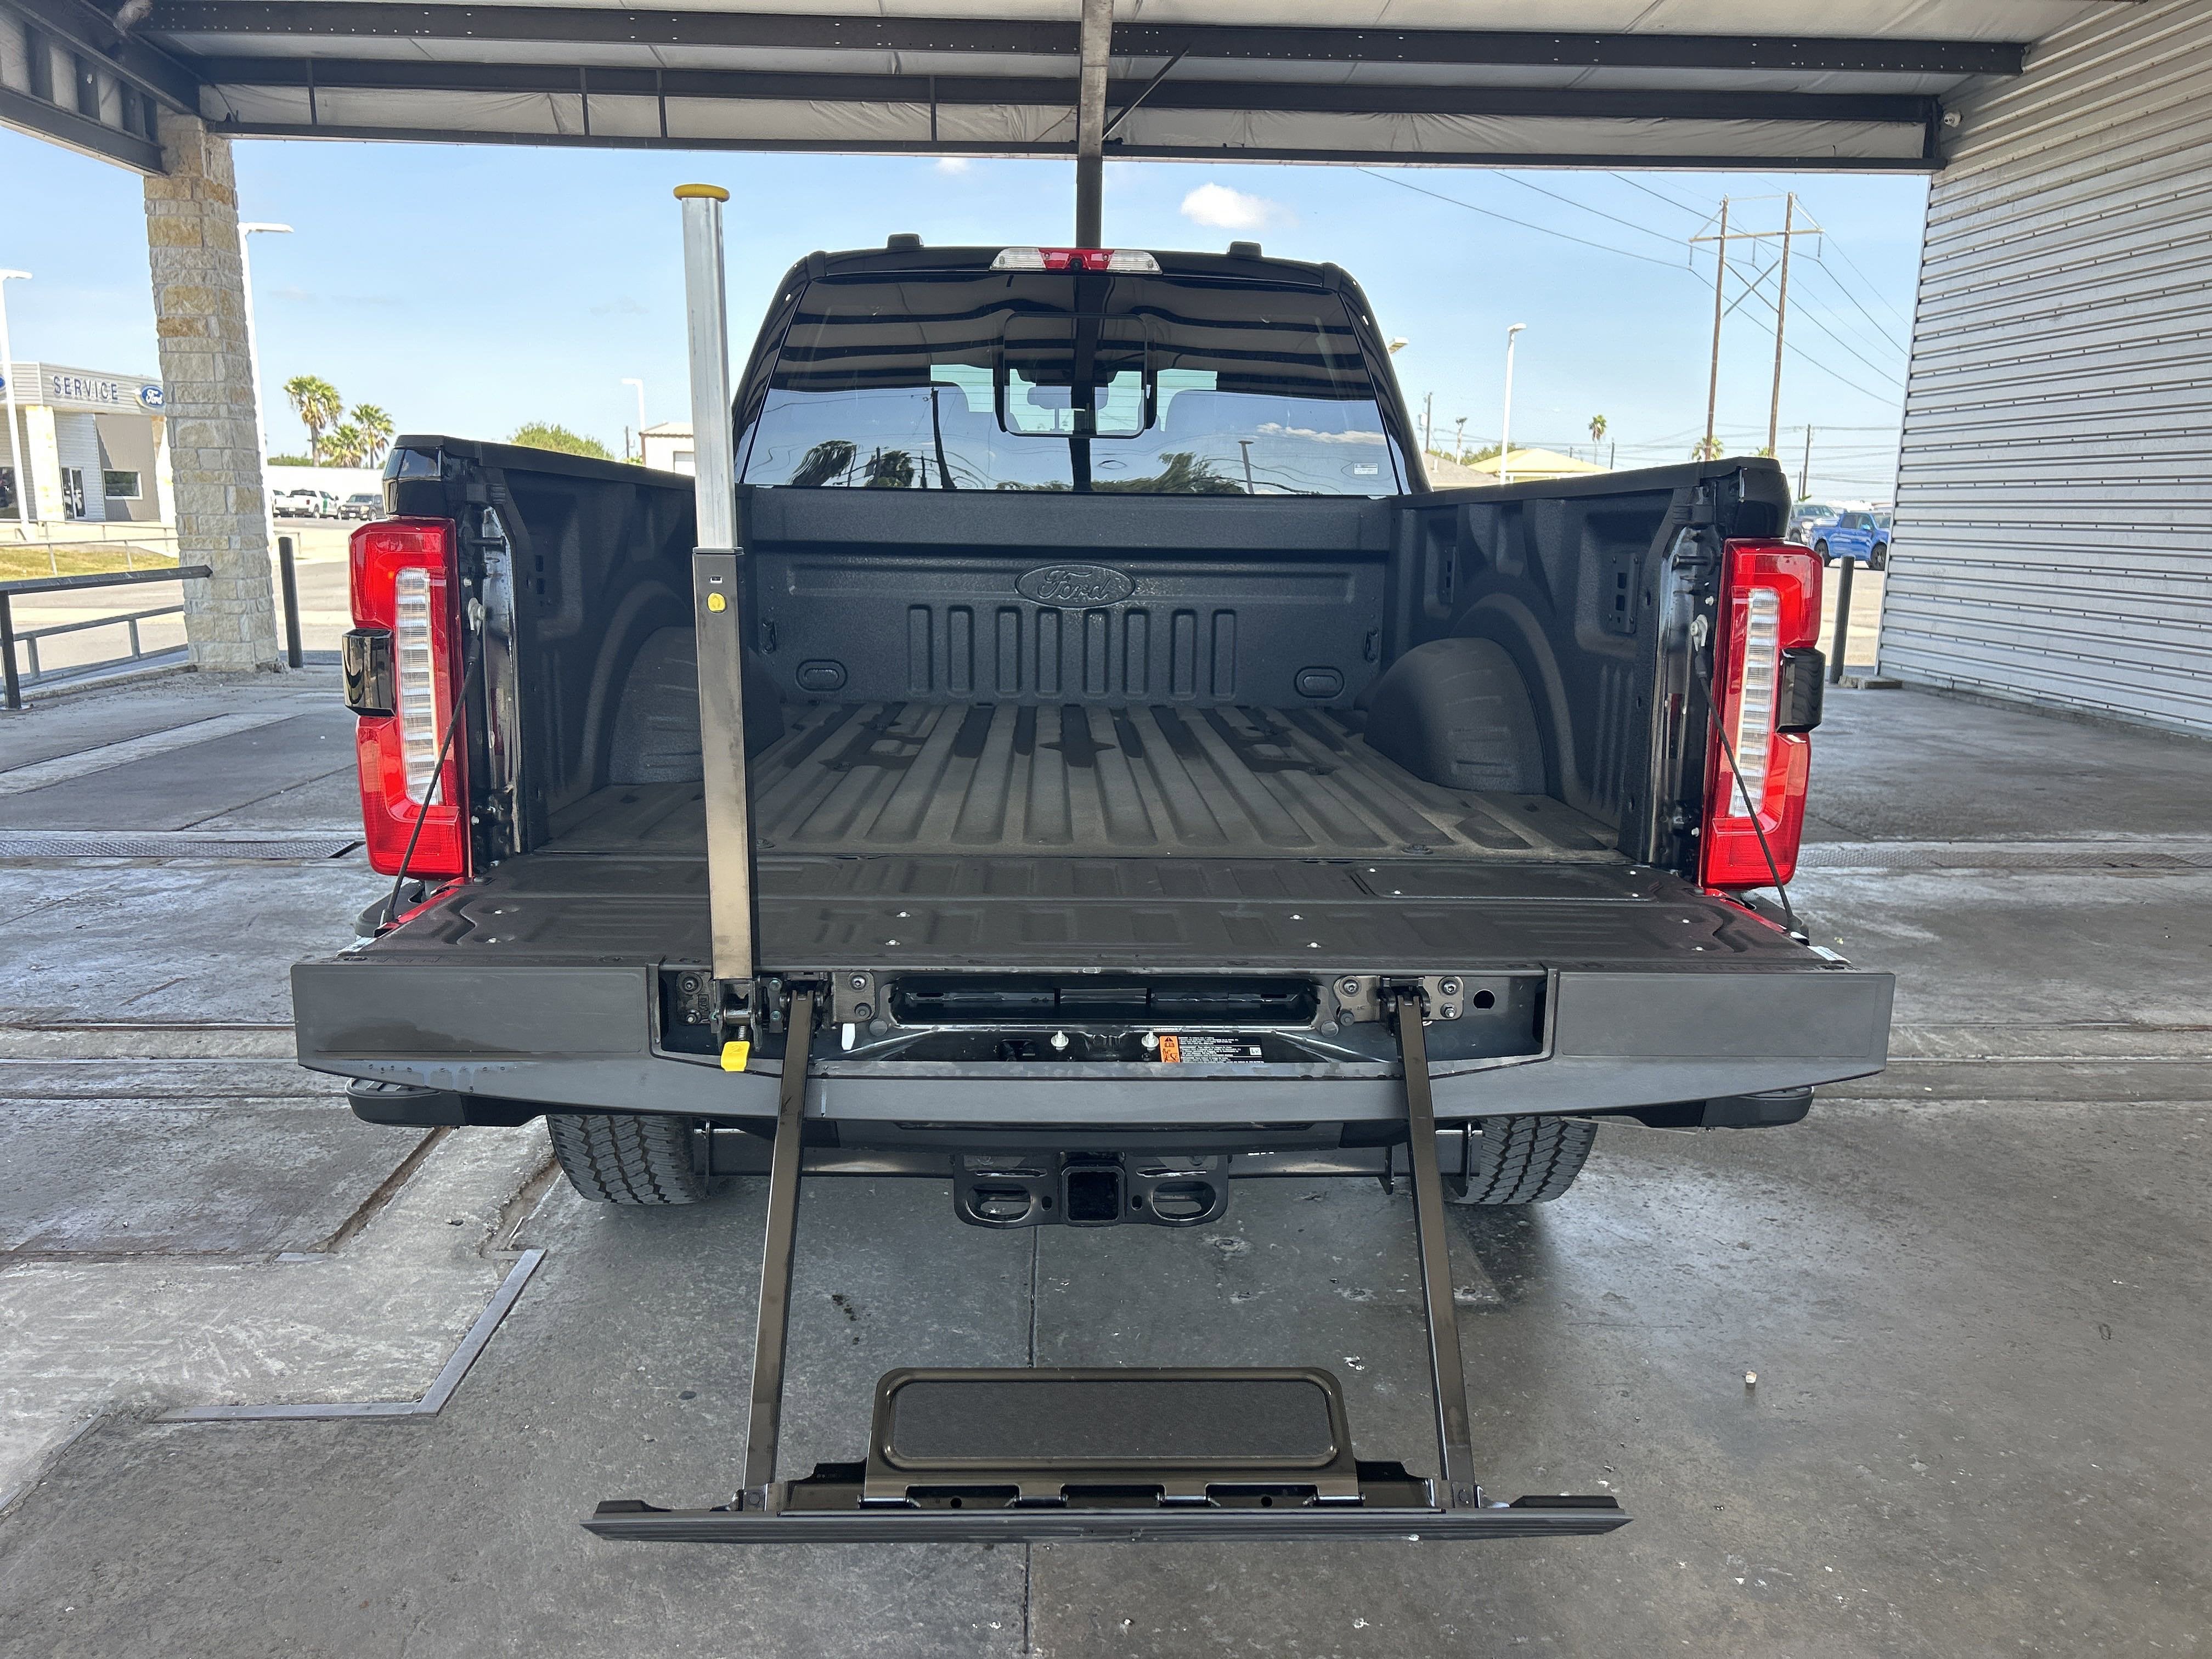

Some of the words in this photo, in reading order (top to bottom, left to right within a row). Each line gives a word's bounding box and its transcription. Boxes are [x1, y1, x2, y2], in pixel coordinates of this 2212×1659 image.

[53, 376, 119, 400] SERVICE
[145, 389, 162, 404] Ford
[1037, 569, 1110, 600] Ford
